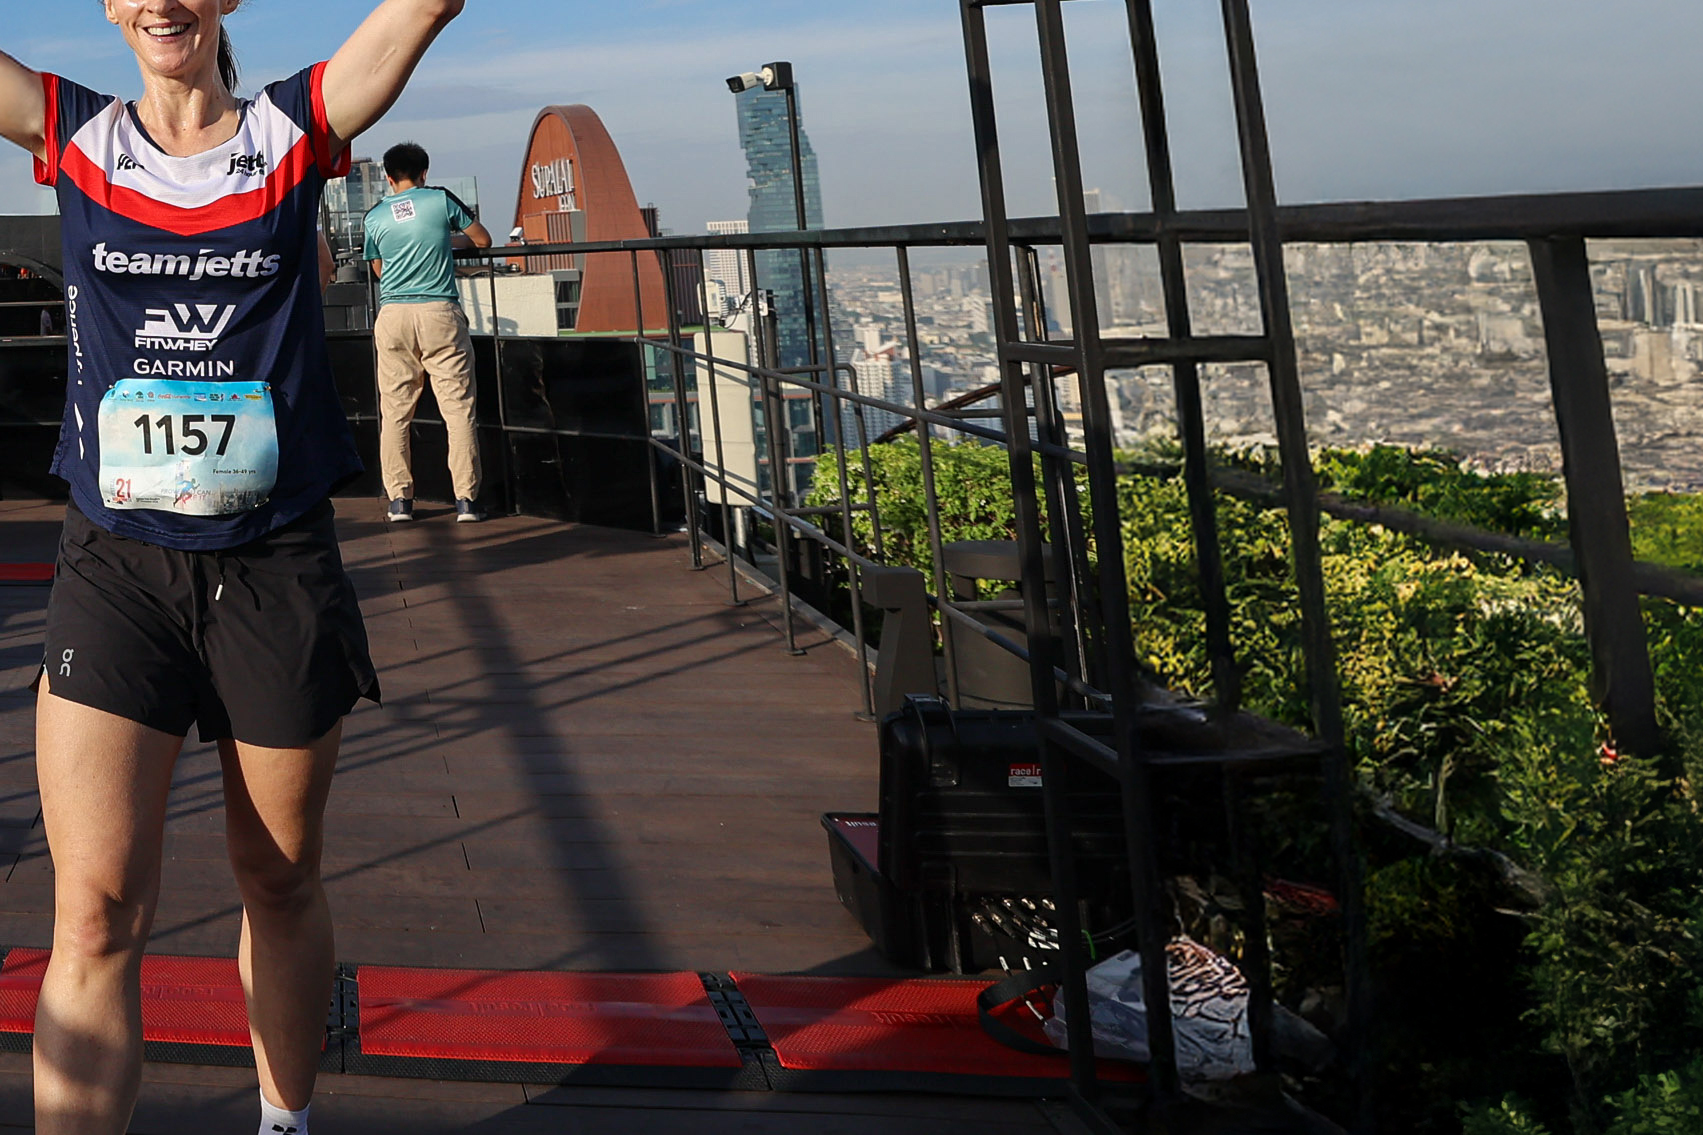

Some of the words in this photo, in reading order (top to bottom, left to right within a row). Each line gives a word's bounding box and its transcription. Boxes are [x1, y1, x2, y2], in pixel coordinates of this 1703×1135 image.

[134, 337, 218, 351] FITWHEY
[133, 358, 234, 377] GARMIN
[134, 414, 236, 456] 1157
